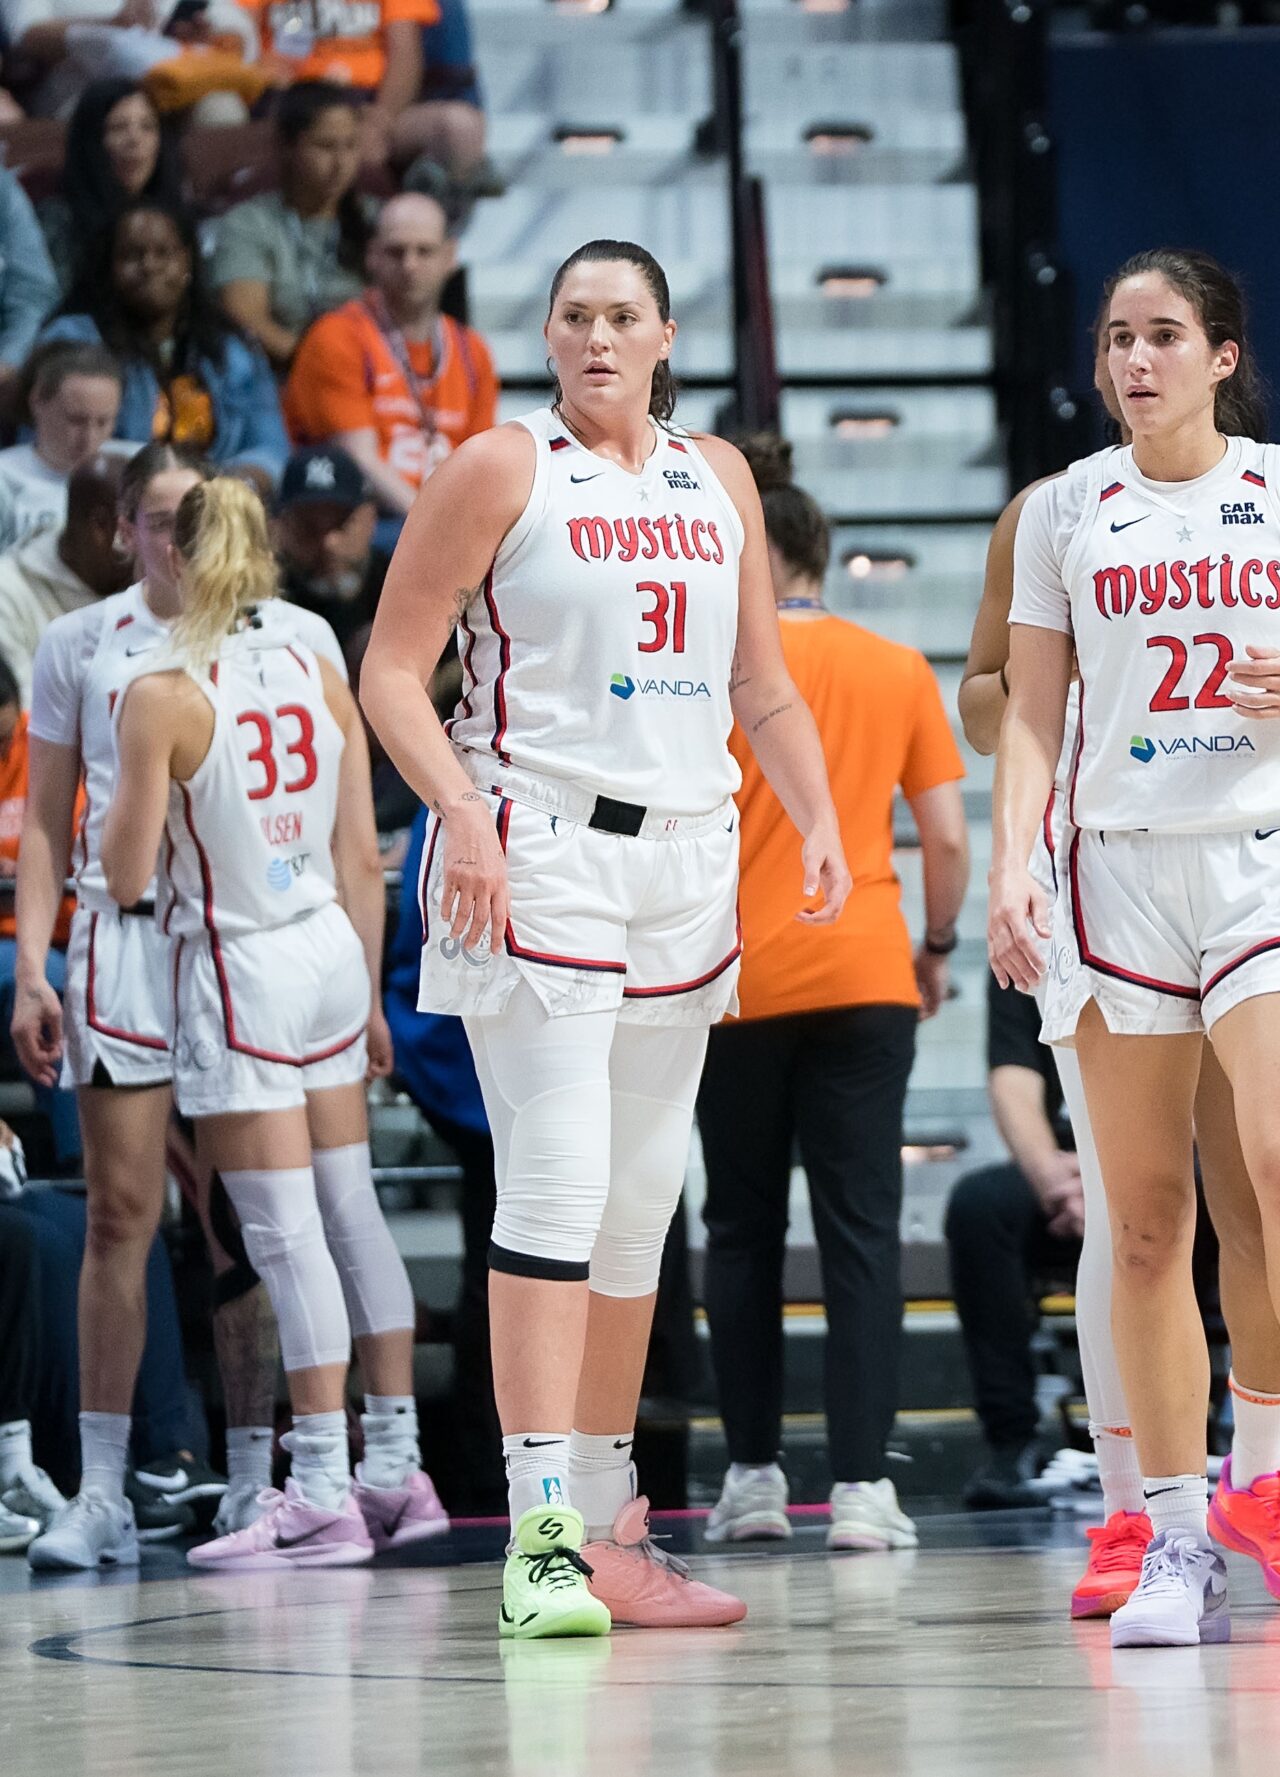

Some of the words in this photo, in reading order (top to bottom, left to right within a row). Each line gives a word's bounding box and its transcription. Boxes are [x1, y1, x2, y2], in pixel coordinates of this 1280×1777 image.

[662, 470, 691, 481] CAR
[668, 479, 701, 490] max
[1220, 502, 1256, 514] CAR
[1221, 512, 1265, 525] max
[636, 580, 687, 653] 31
[1146, 632, 1235, 712] 22
[637, 678, 711, 698] VANDA
[236, 703, 318, 800] 33
[1158, 735, 1256, 754] VANDA
